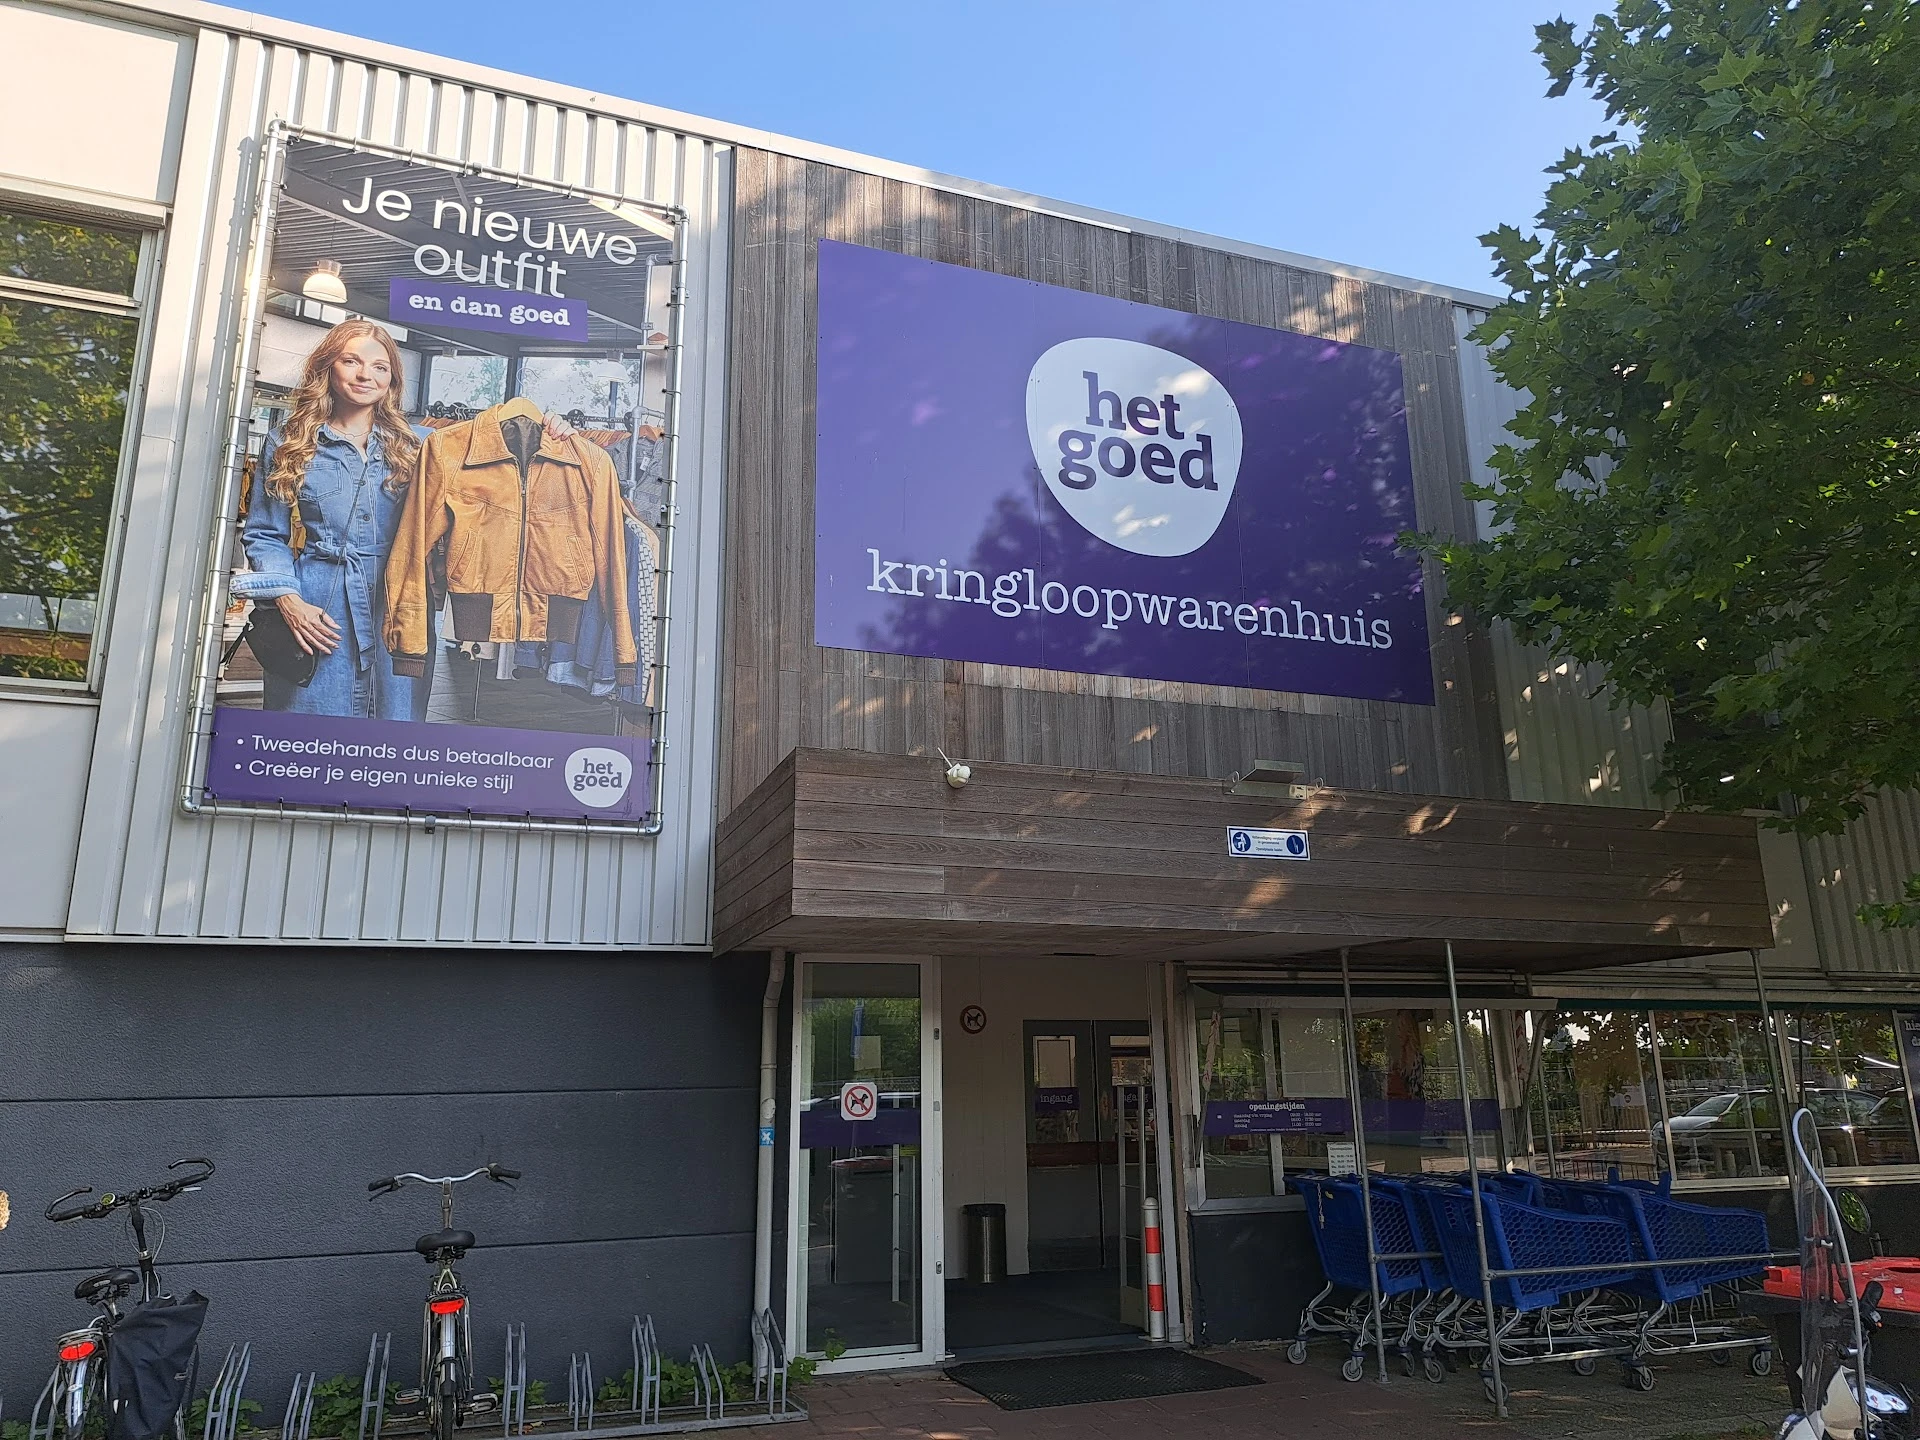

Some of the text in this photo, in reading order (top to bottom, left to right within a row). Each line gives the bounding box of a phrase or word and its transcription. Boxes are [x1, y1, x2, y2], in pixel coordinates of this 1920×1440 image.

[342, 177, 638, 265] Je nieuwe
[413, 244, 567, 298] outfit
[409, 292, 570, 326] en dan goed
[1082, 371, 1184, 440] het
[1057, 430, 1218, 492] goed
[866, 548, 1394, 650] kringloopwarenhuis
[253, 735, 554, 769] Tweedehands dus betaalbaar
[583, 758, 614, 775] het
[249, 761, 513, 793] Creëer je eigen unieke stijl
[573, 772, 623, 791] goed
[1040, 1094, 1073, 1104] ingang
[1249, 1102, 1305, 1111] openingstijden
